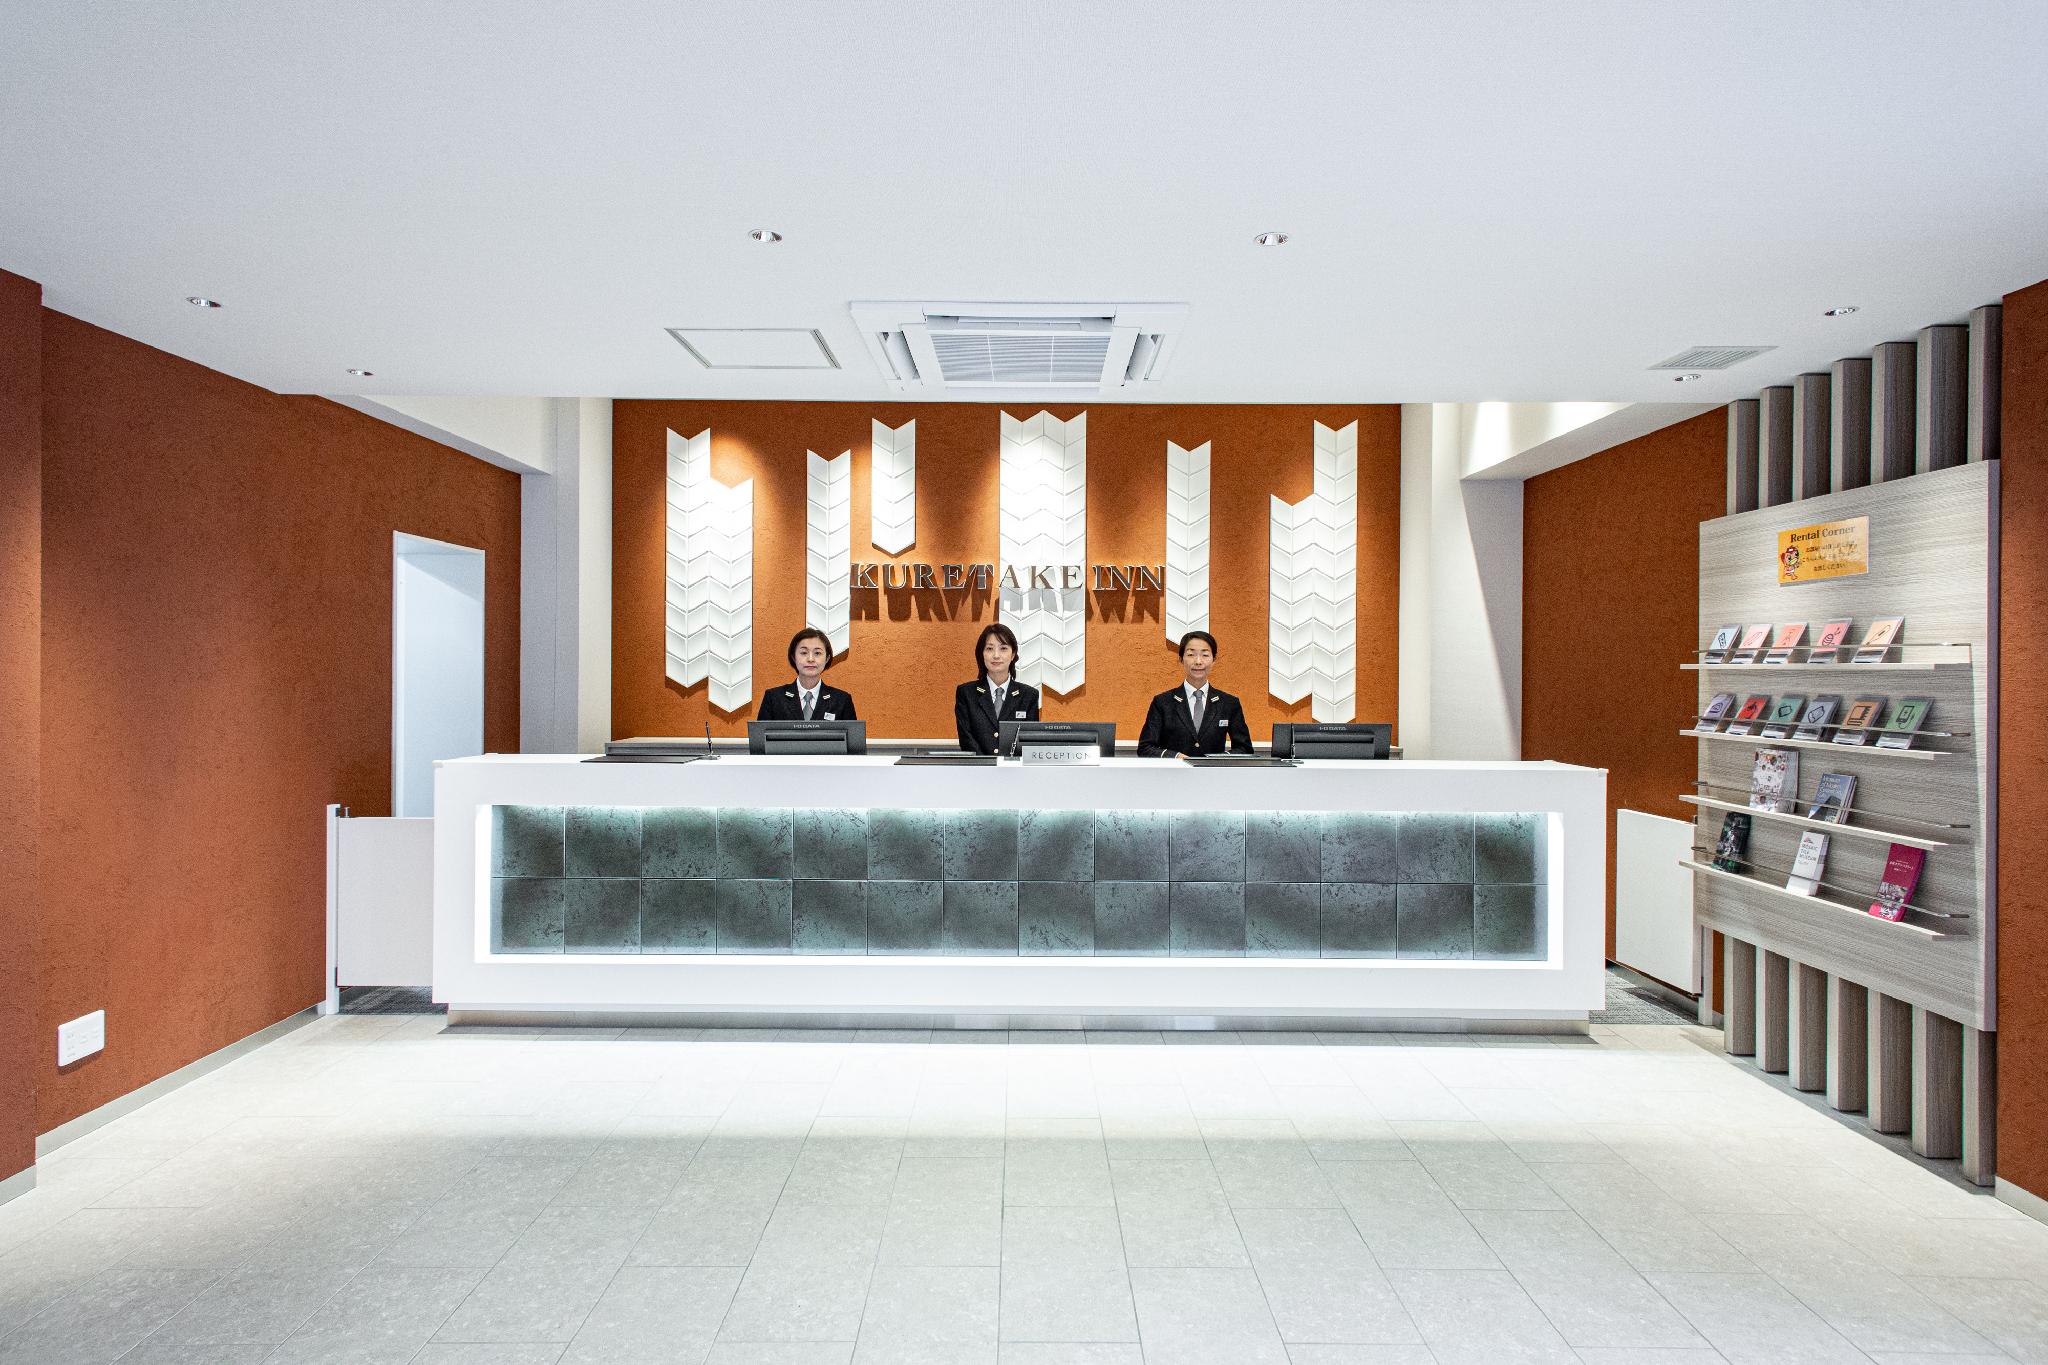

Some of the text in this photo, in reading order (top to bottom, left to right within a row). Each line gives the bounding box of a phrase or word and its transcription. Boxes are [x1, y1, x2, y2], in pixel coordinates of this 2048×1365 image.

[1790, 526, 1856, 543] Rental Corner
[851, 563, 1166, 591] KURETAKE INN
[1032, 751, 1091, 760] RECEPTION
